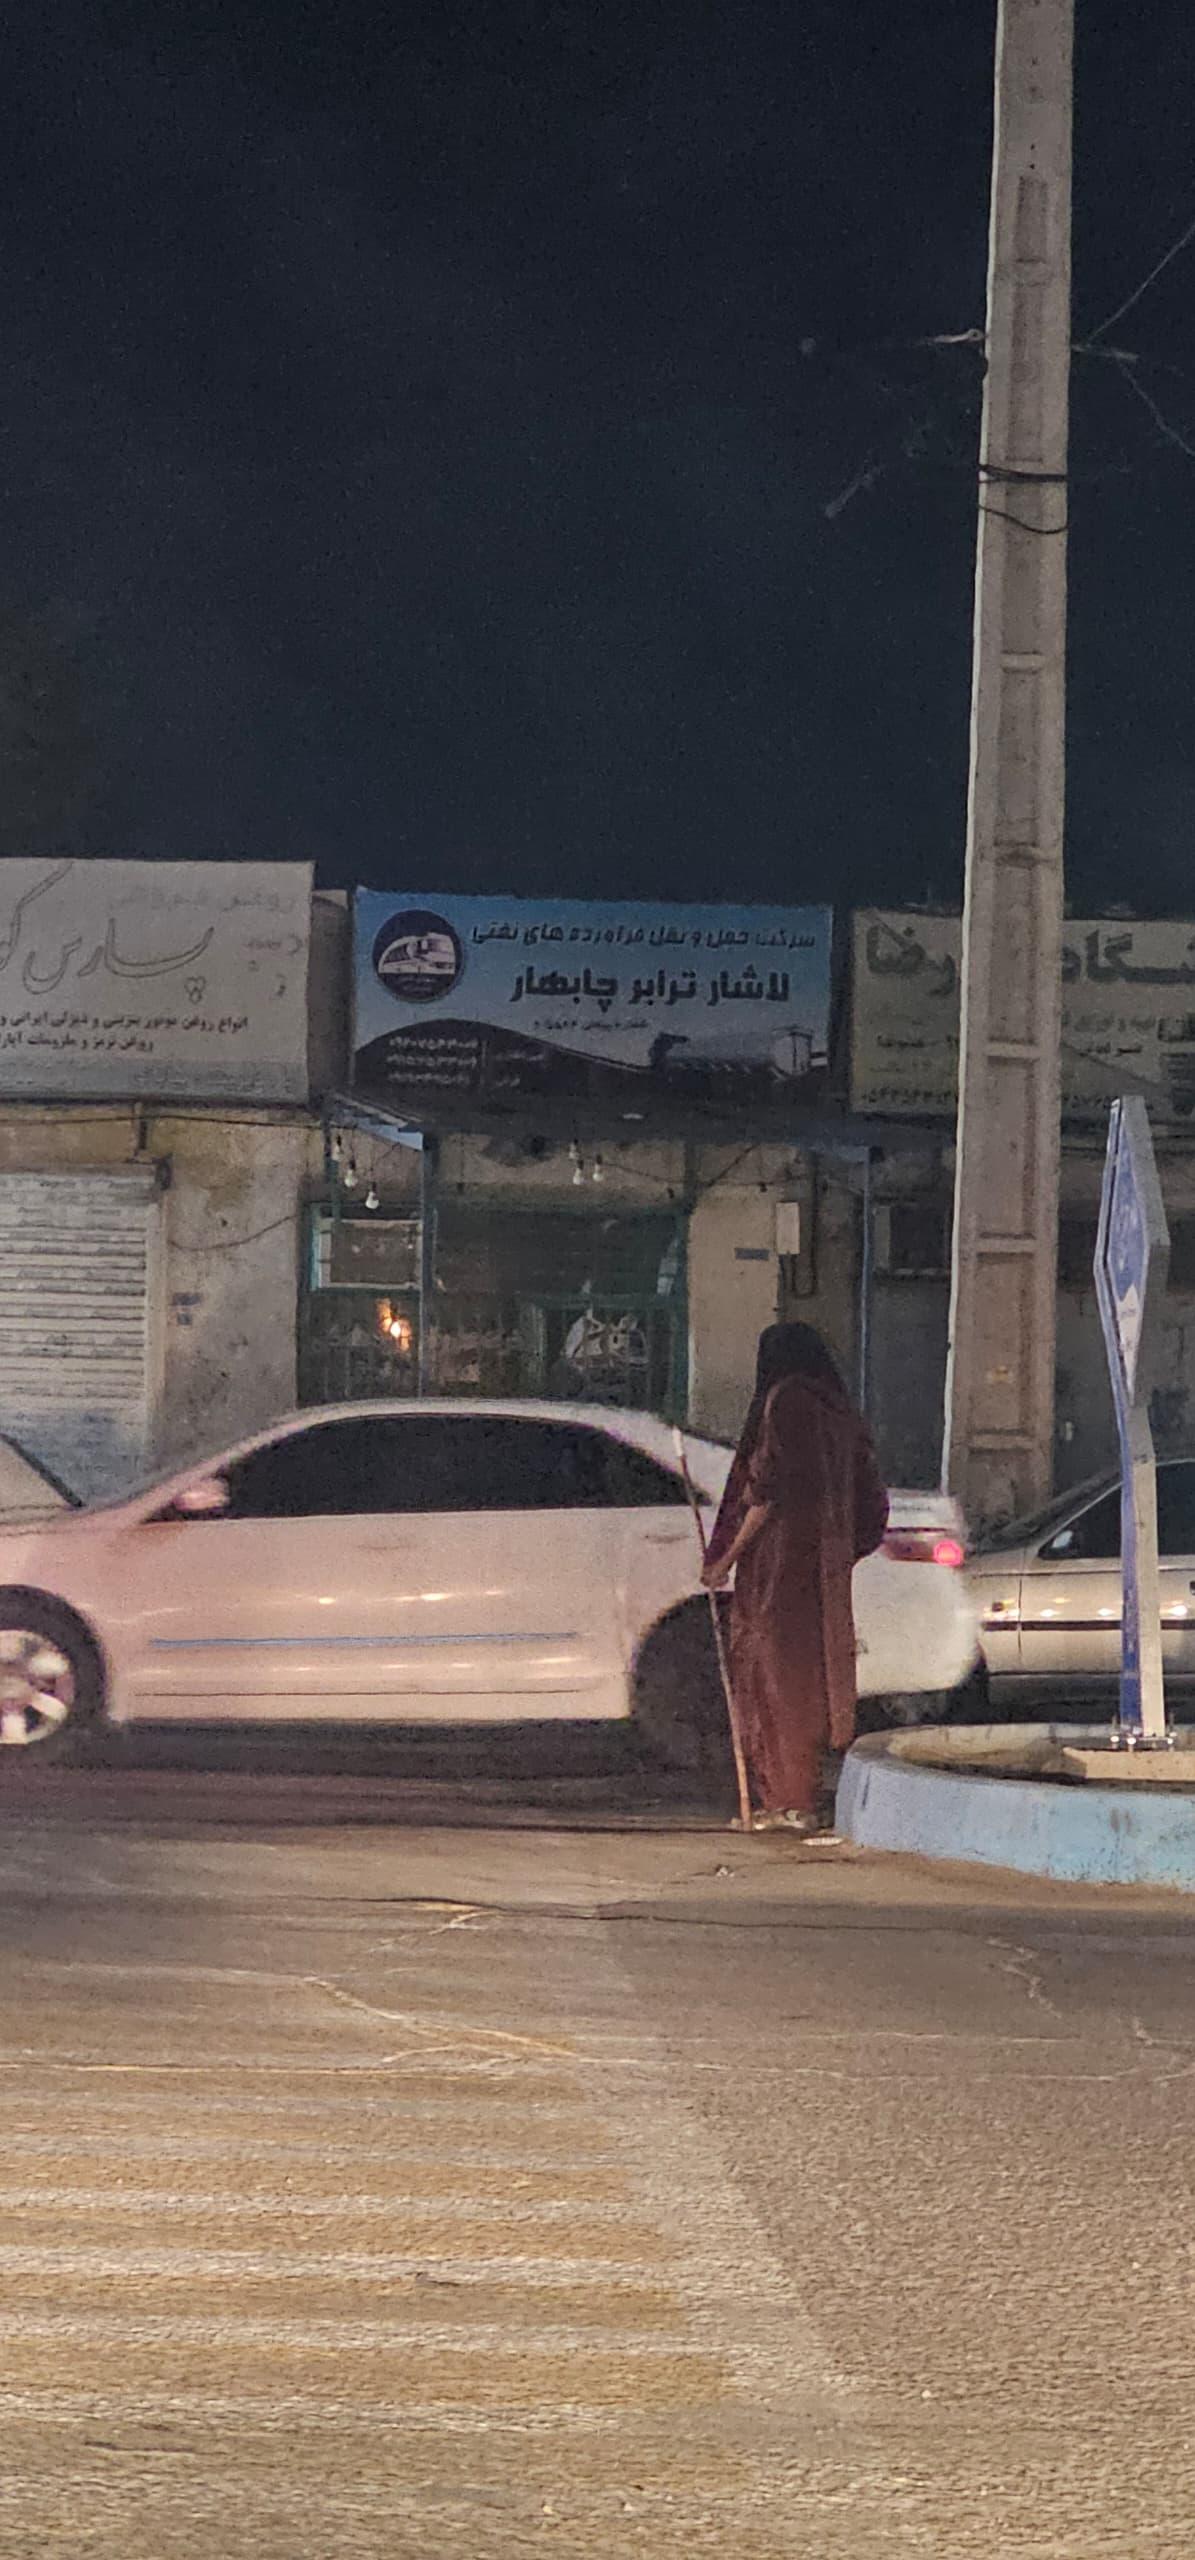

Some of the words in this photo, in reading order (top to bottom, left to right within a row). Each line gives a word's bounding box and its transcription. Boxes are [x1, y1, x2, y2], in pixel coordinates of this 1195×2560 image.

[471, 921, 519, 945] نفتی
[523, 921, 565, 946] های
[649, 924, 686, 947] نقل
[691, 930, 702, 948] و
[706, 927, 750, 949] حمل
[509, 965, 619, 1013] چابهار
[628, 968, 697, 1006] ترابر
[706, 964, 790, 1007] لاشار
[181, 1016, 216, 1032] روغن
